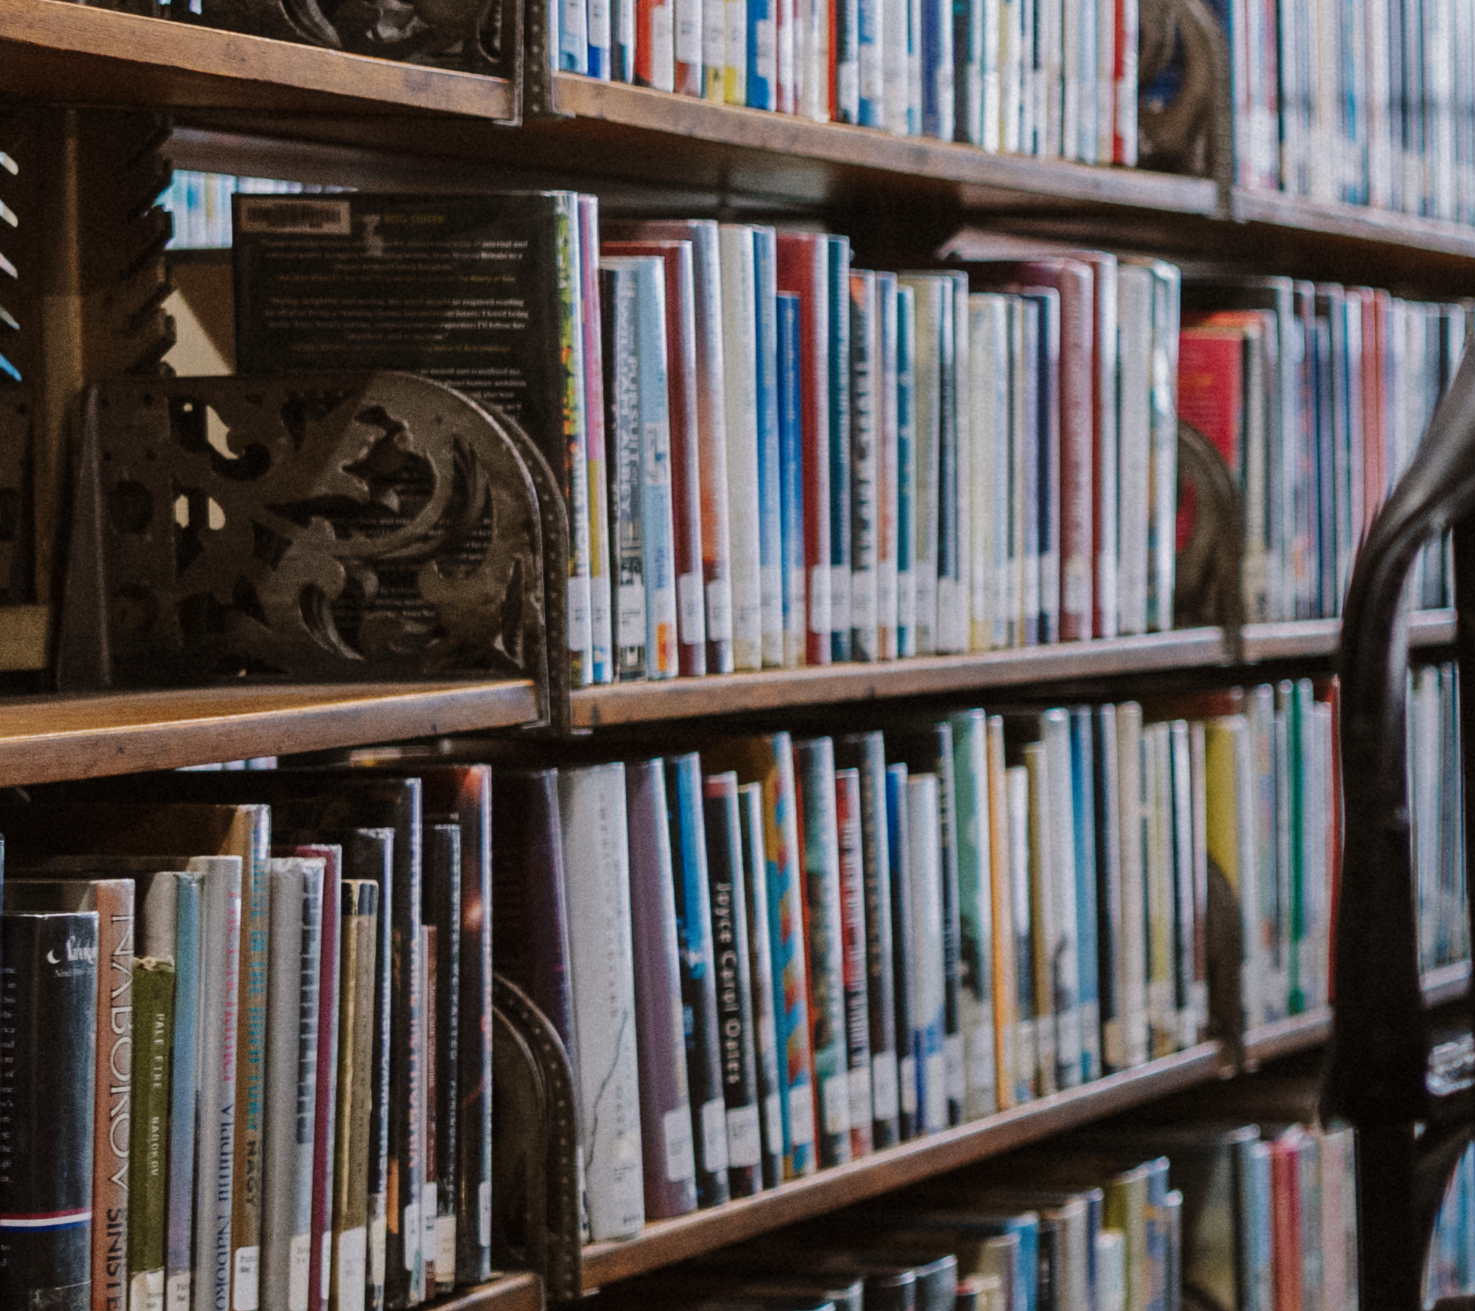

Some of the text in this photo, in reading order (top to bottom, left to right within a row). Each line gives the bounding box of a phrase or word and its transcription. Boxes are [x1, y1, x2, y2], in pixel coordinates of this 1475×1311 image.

[153, 1012, 165, 1050] PALE
[716, 881, 742, 1085] Joyce Carol Oates
[103, 912, 135, 1311] NABOKOV SINISTE
[151, 1114, 163, 1177] NABOKOV
